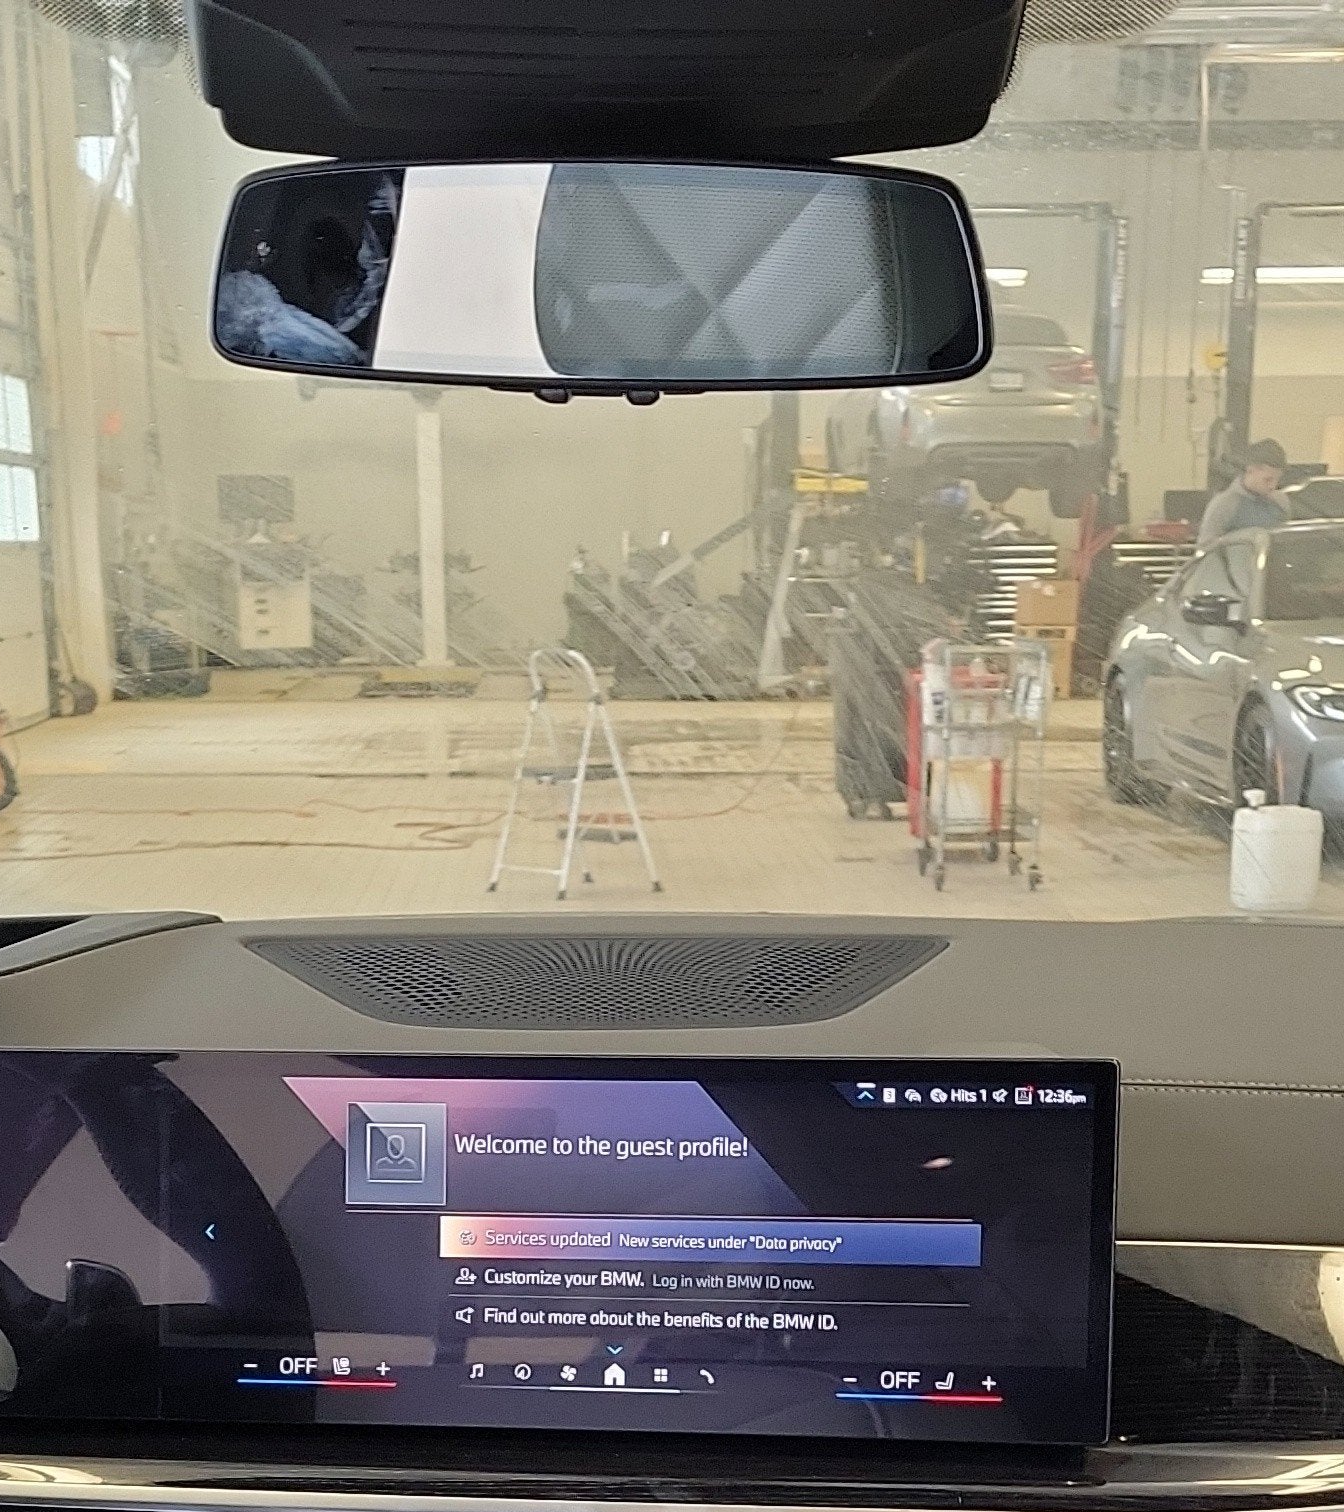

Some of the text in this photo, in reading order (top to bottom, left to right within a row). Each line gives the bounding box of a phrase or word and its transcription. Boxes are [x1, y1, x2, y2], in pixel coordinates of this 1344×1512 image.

[950, 1088, 987, 1103] Hits 1
[455, 1134, 748, 1160] Welcome to the guest profile!
[485, 1230, 611, 1249] Services updated
[619, 1233, 842, 1252] New services under "Data privacy"
[484, 1268, 645, 1288] Customize your BMW.
[652, 1274, 815, 1290] Log in with BMW ID now.
[484, 1308, 838, 1330] Find out more about the benefits of the BMW ID.
[279, 1357, 318, 1375] OFF
[880, 1371, 920, 1389] OFF
